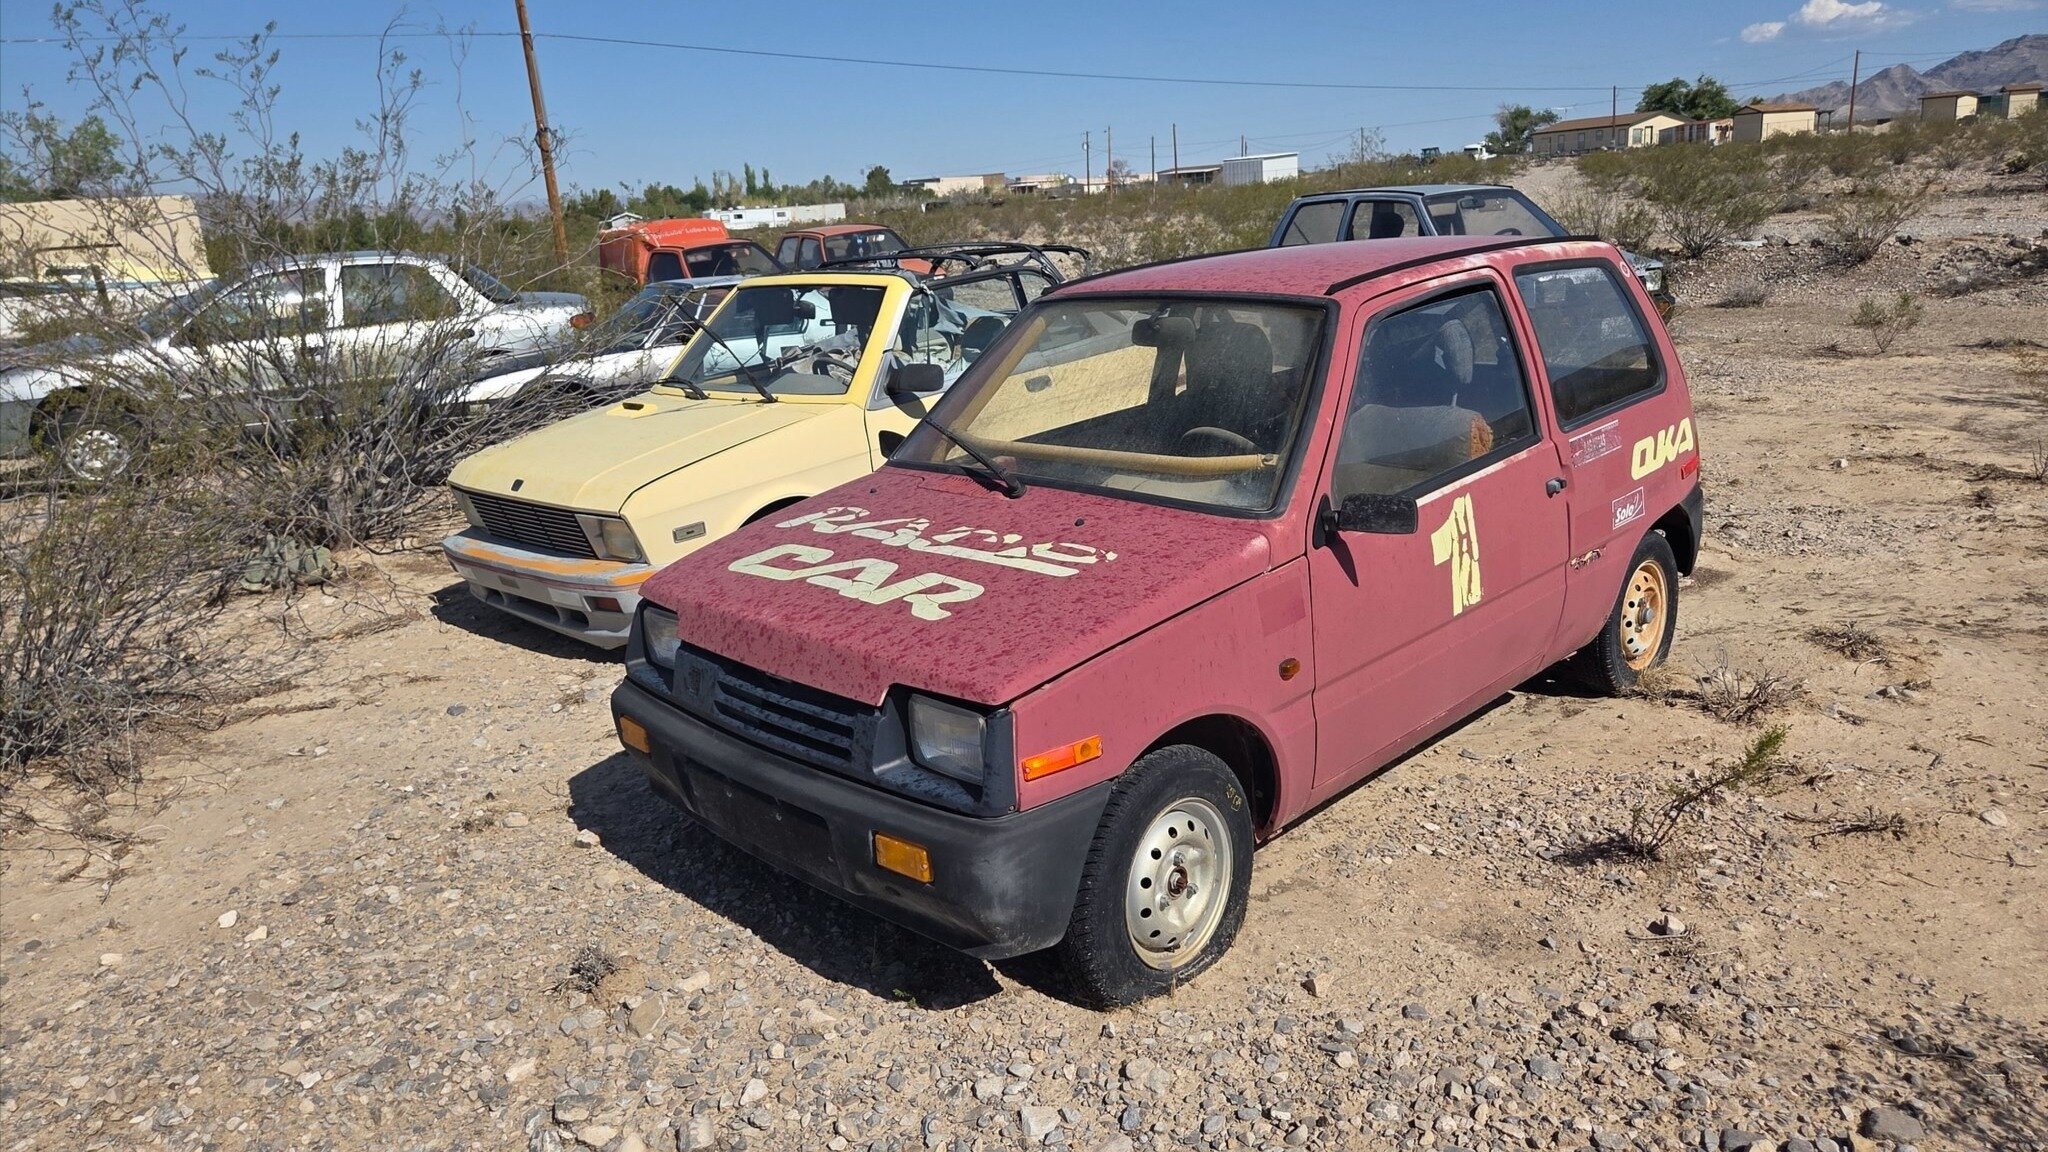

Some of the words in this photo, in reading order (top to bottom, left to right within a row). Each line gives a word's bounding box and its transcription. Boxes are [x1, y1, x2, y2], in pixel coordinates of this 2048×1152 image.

[1631, 417, 1694, 481] OKA
[1615, 503, 1635, 523] Solo
[728, 543, 985, 621] CAR
